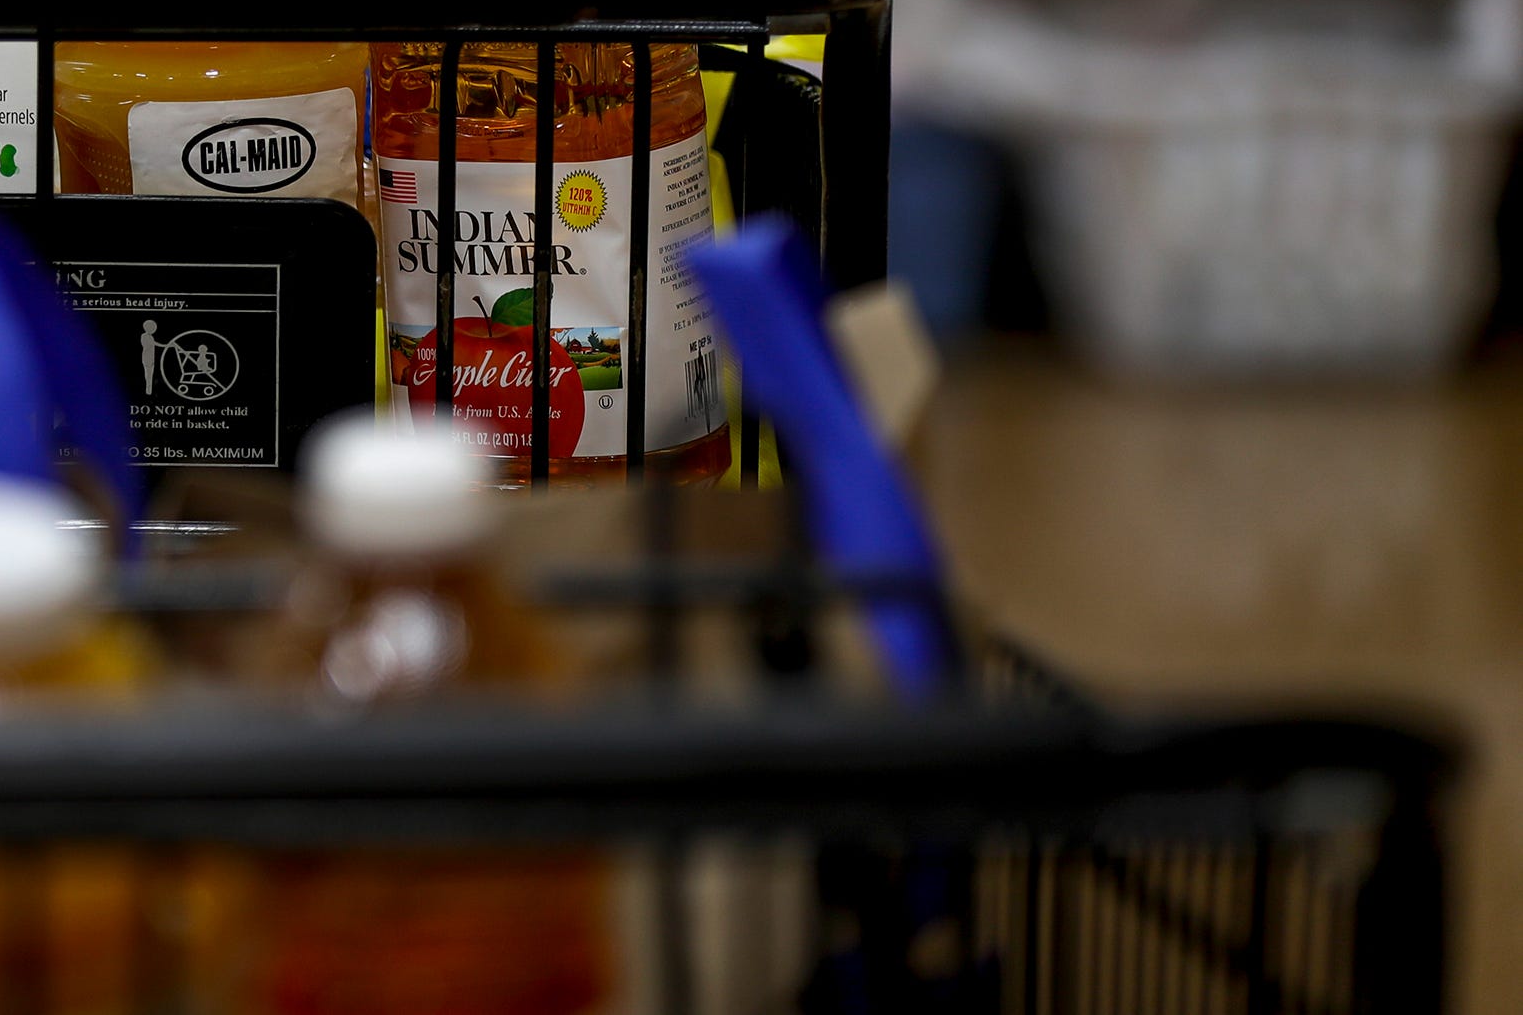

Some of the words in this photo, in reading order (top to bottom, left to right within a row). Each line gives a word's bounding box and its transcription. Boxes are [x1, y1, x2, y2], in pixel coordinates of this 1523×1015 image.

[200, 135, 302, 175] CAL-MAID
[569, 187, 593, 202] 120%
[562, 202, 591, 216] VITAMIN
[592, 206, 597, 216] C
[82, 298, 121, 307] serious
[126, 298, 151, 307] head
[154, 298, 189, 310] injury.
[130, 405, 151, 415] DO
[155, 405, 184, 415] NOT
[187, 406, 217, 416] allow
[221, 406, 248, 416] child
[464, 404, 493, 420] from
[497, 405, 521, 419] U.S.
[525, 406, 561, 419] Ales
[130, 419, 141, 428] to
[145, 419, 168, 428] ride
[171, 419, 183, 428] in
[186, 419, 230, 429] basket.
[477, 433, 490, 445] OZ.
[143, 447, 160, 458] 35
[164, 447, 187, 458] lbs.
[191, 447, 264, 459] MAXIMUM
